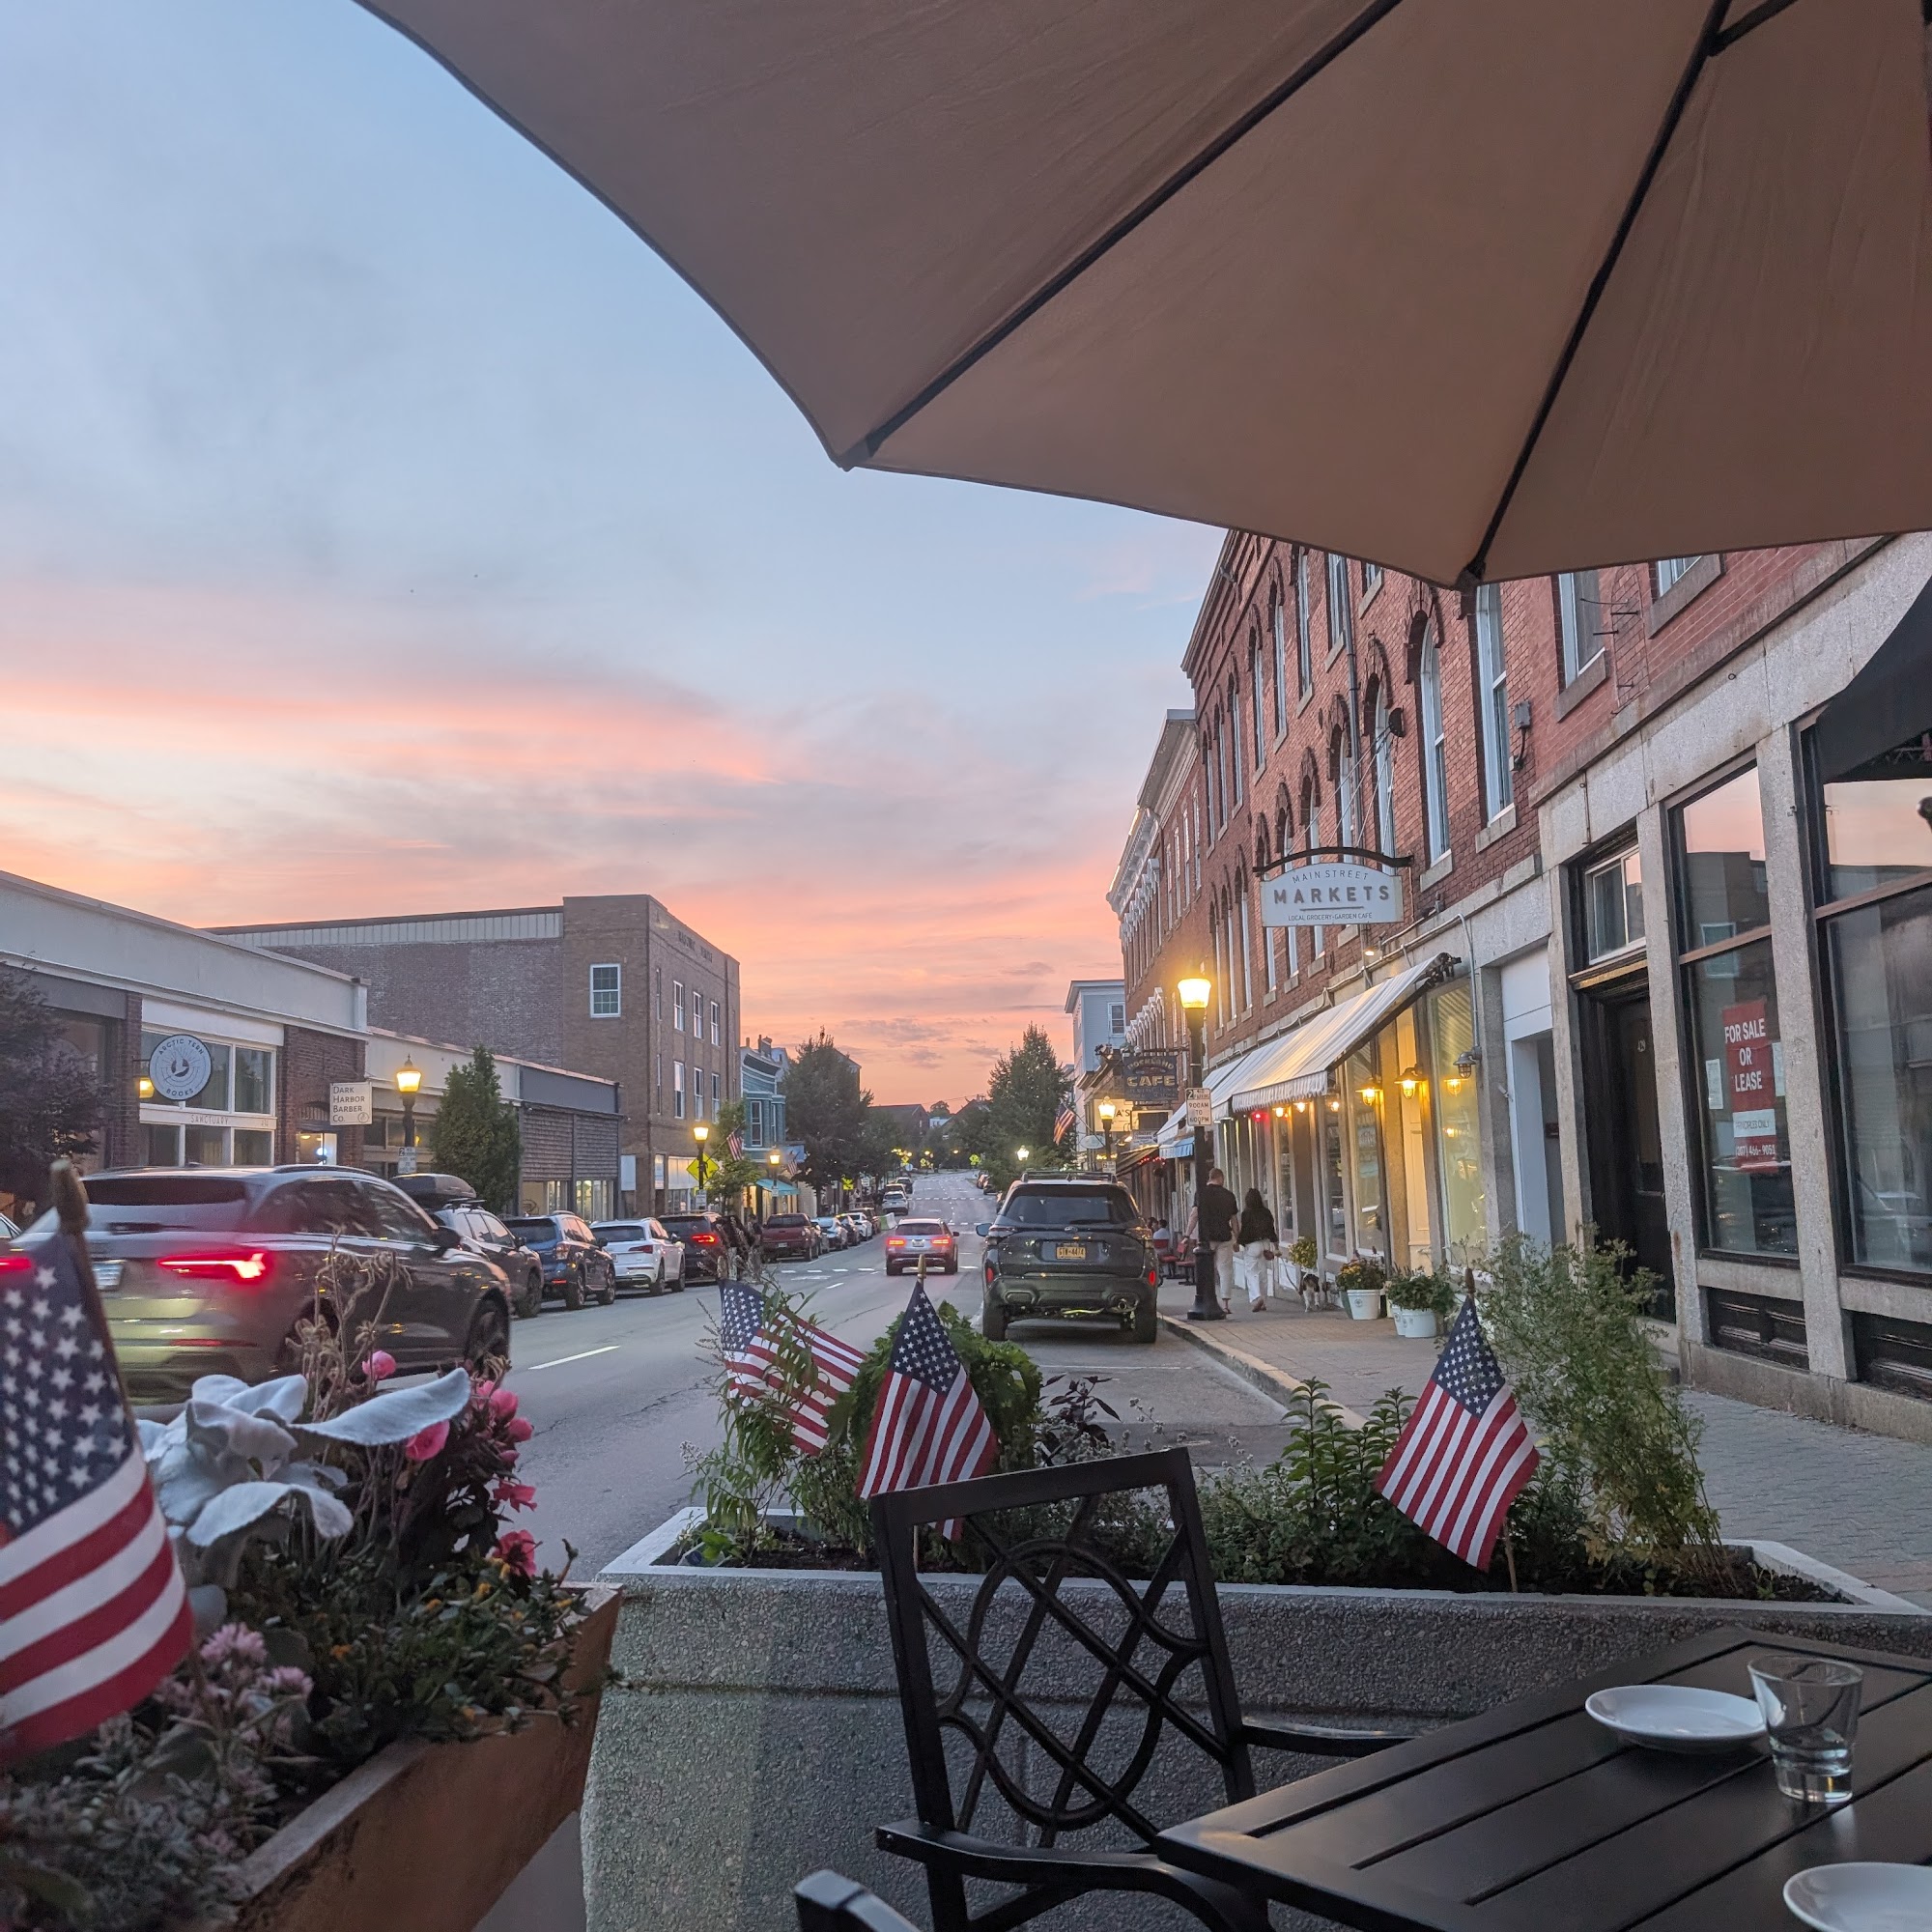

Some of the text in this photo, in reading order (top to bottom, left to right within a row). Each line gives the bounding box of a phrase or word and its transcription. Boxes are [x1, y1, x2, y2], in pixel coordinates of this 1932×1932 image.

[1292, 869, 1369, 884] MAIN STREET
[1273, 886, 1390, 904] MARKETS
[1724, 1017, 1766, 1043] FOR SALE
[158, 1038, 204, 1055] ARCTIC TERN
[1739, 1046, 1752, 1066] OR
[1126, 1075, 1176, 1087] CAFE
[1734, 1069, 1763, 1093] LEASE
[166, 1088, 194, 1097] BOOKS
[333, 1086, 355, 1094] DARK
[1188, 1090, 1194, 1100] 2
[333, 1094, 365, 1103] HARBOR
[333, 1104, 363, 1113] BARBER
[190, 1114, 229, 1125] SANCTUARY
